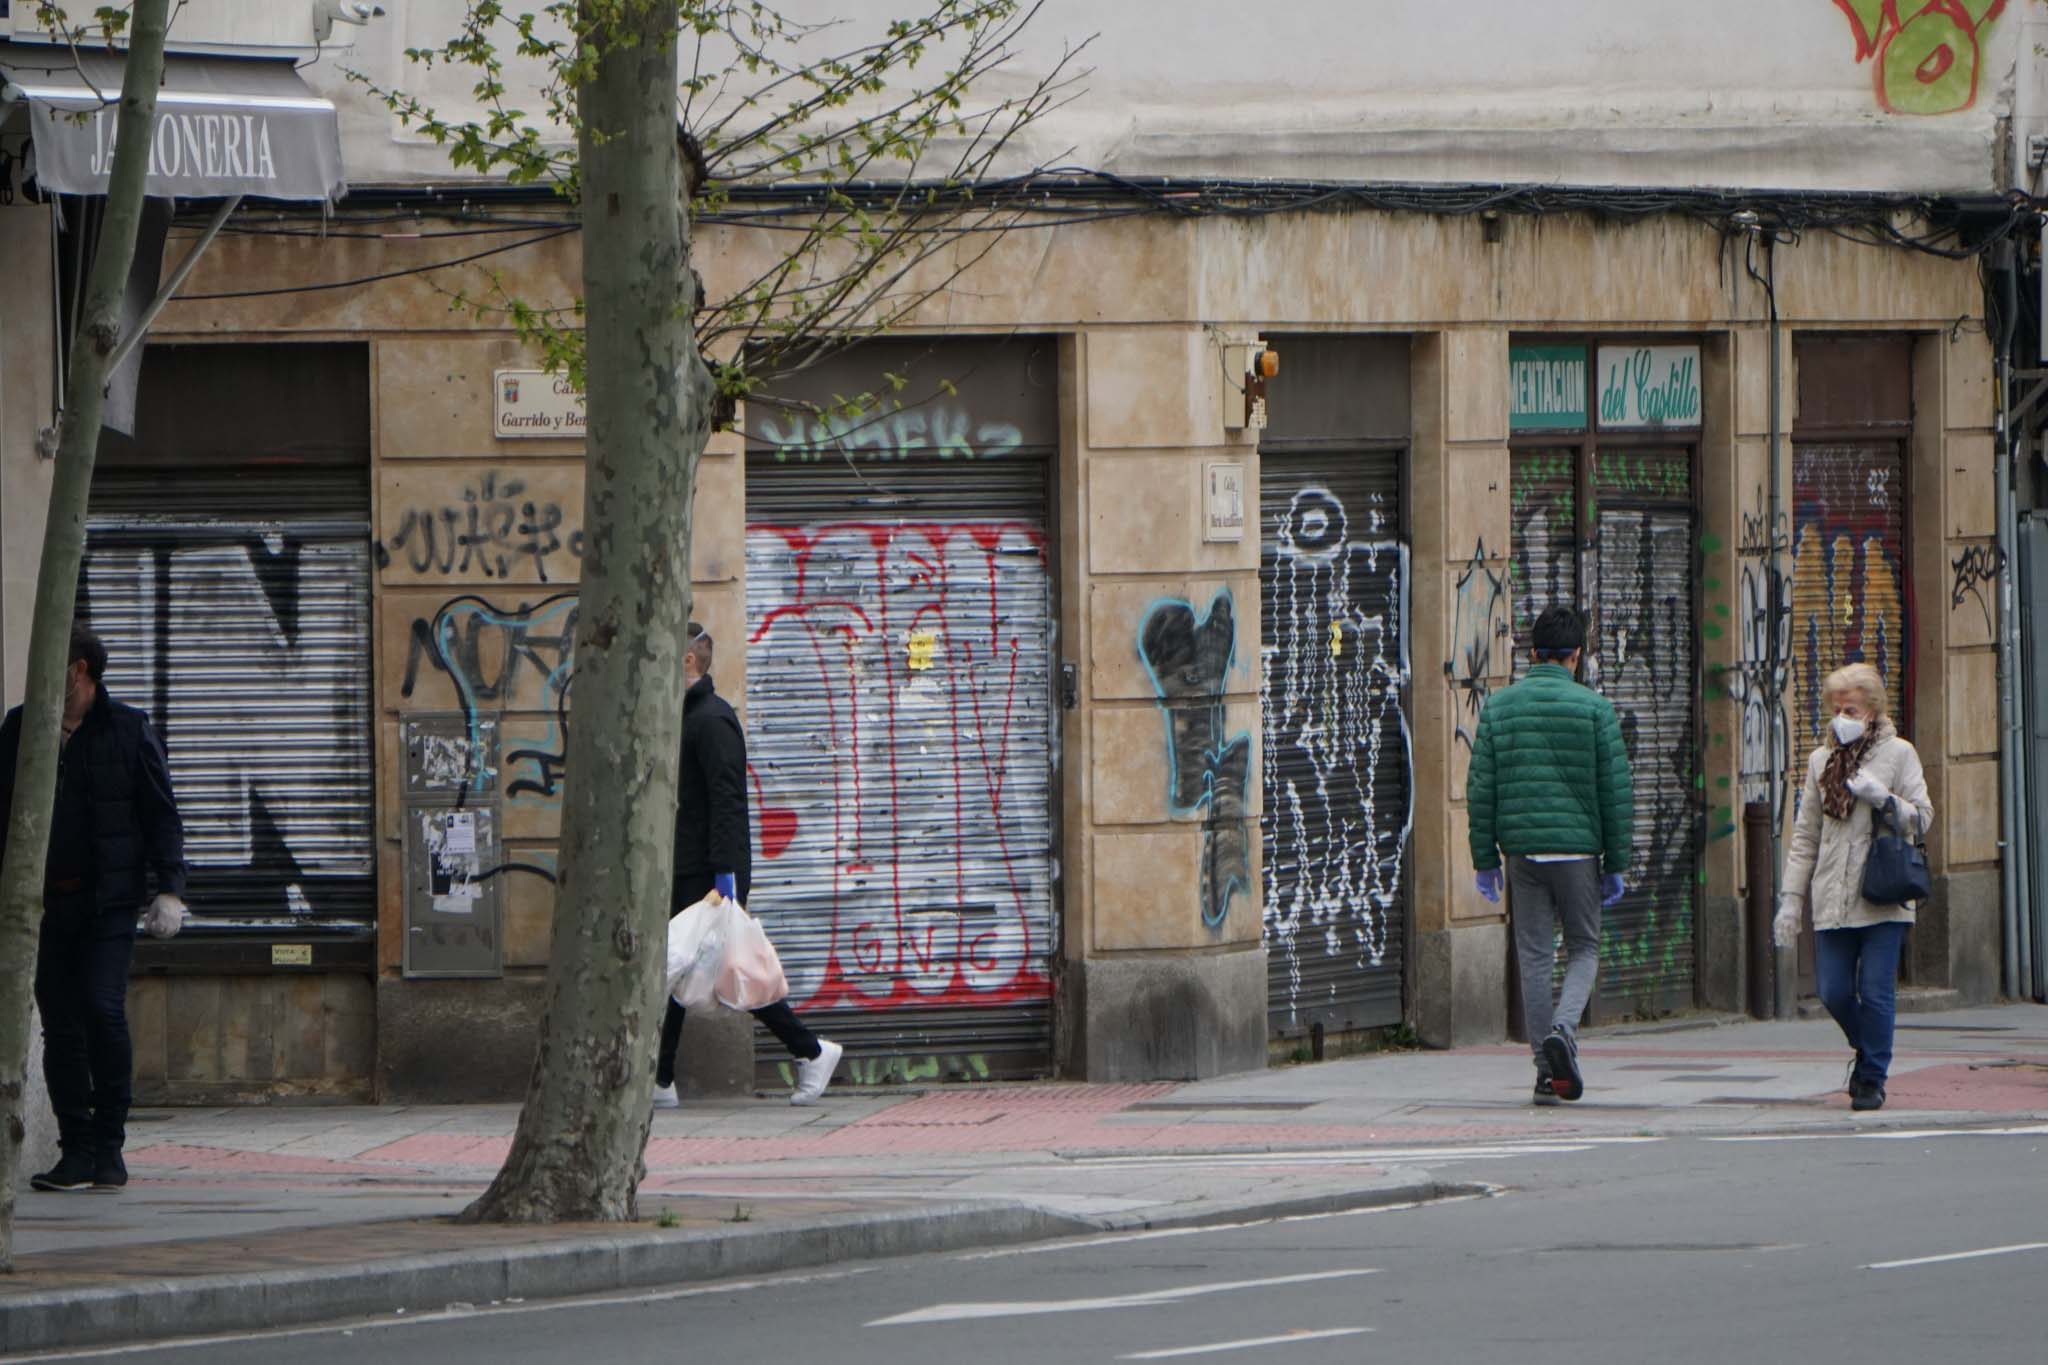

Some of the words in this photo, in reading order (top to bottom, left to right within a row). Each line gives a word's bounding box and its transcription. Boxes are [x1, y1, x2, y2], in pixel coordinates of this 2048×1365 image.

[91, 112, 276, 178] JAONERIA
[1602, 357, 1629, 422] del
[1633, 350, 1698, 420] Castillo
[502, 412, 550, 427] Garrido
[553, 416, 564, 430] y
